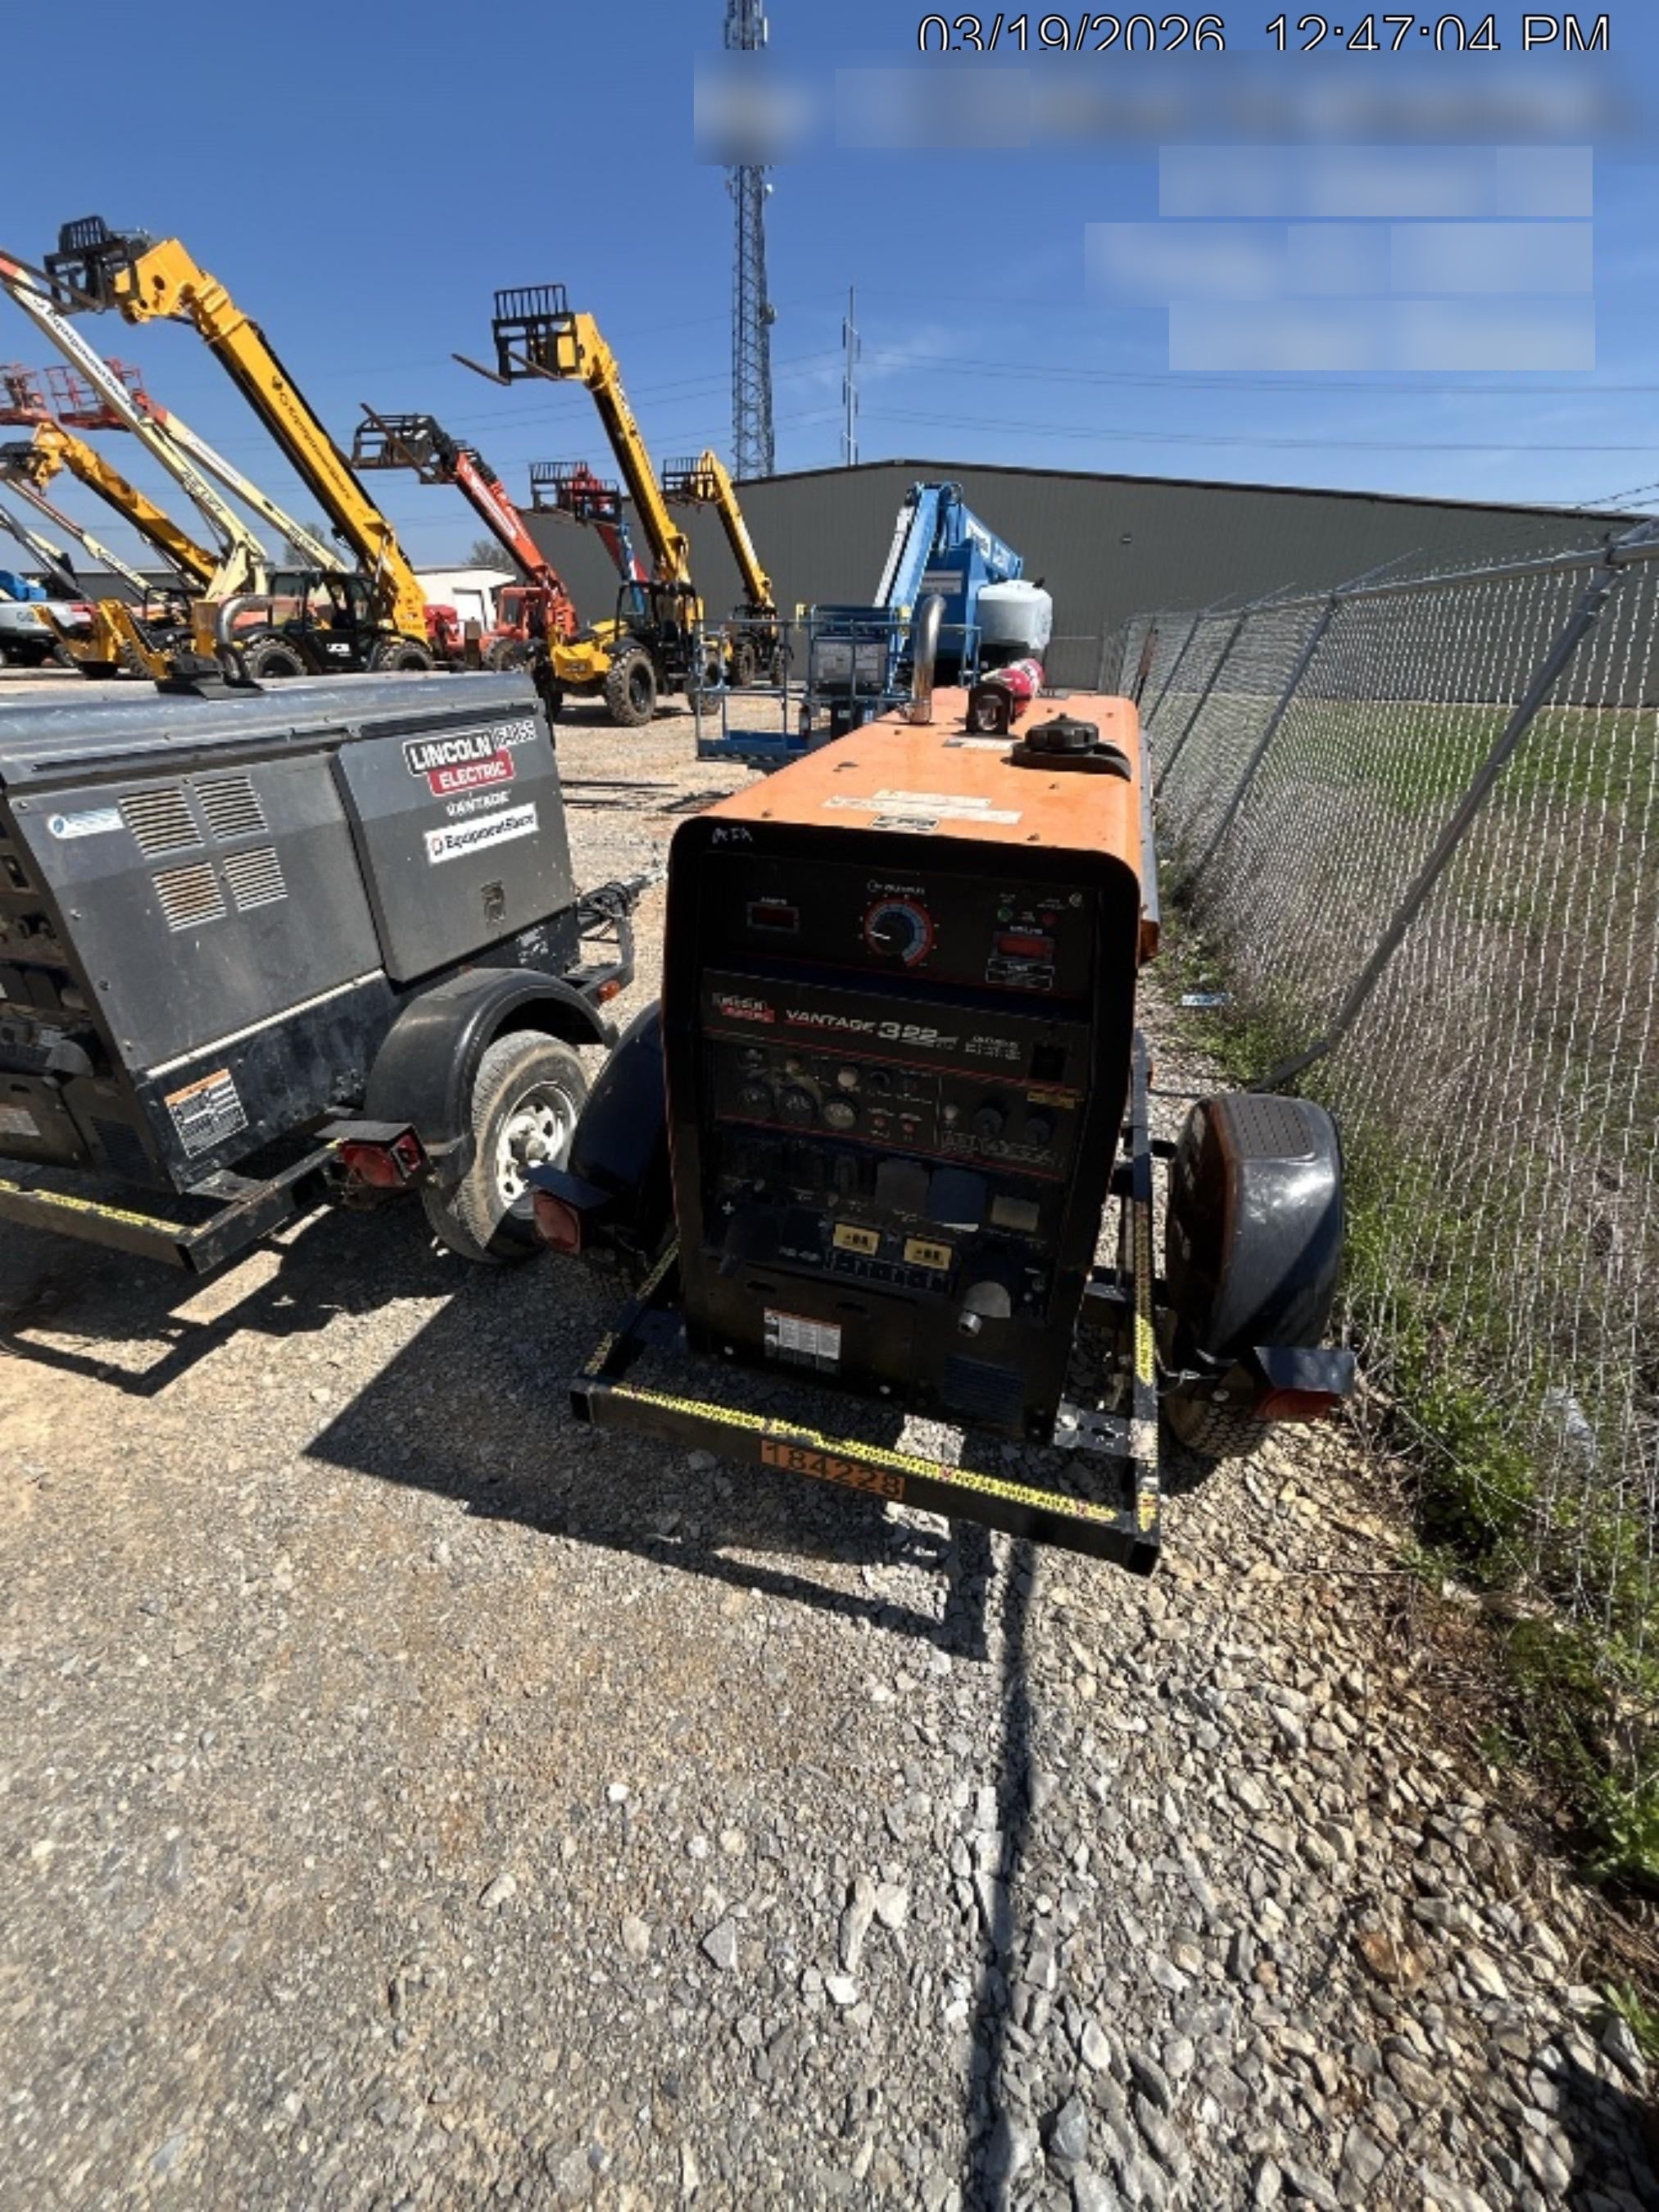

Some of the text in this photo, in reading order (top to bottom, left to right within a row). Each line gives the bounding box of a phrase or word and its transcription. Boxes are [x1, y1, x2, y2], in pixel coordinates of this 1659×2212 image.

[410, 733, 493, 771] LINCOLN
[438, 760, 507, 791] ELECTRIC
[785, 1009, 876, 1034] VANTAGE
[766, 1445, 900, 1496] 184228
